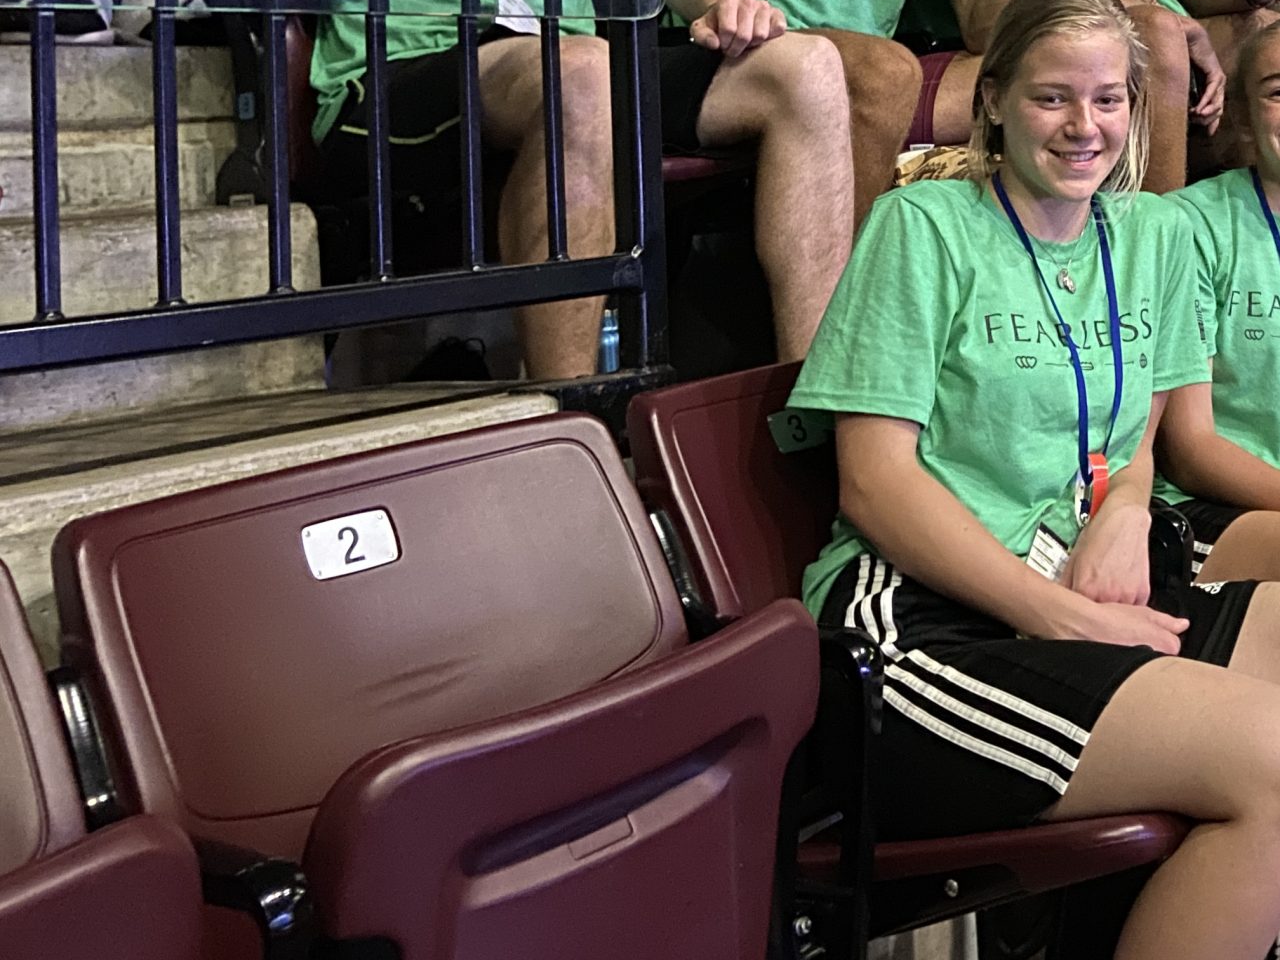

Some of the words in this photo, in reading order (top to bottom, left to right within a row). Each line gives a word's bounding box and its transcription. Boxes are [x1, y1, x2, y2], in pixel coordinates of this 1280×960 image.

[984, 307, 1153, 349] FEARLESS
[787, 415, 808, 443] 3
[337, 526, 366, 565] 2
